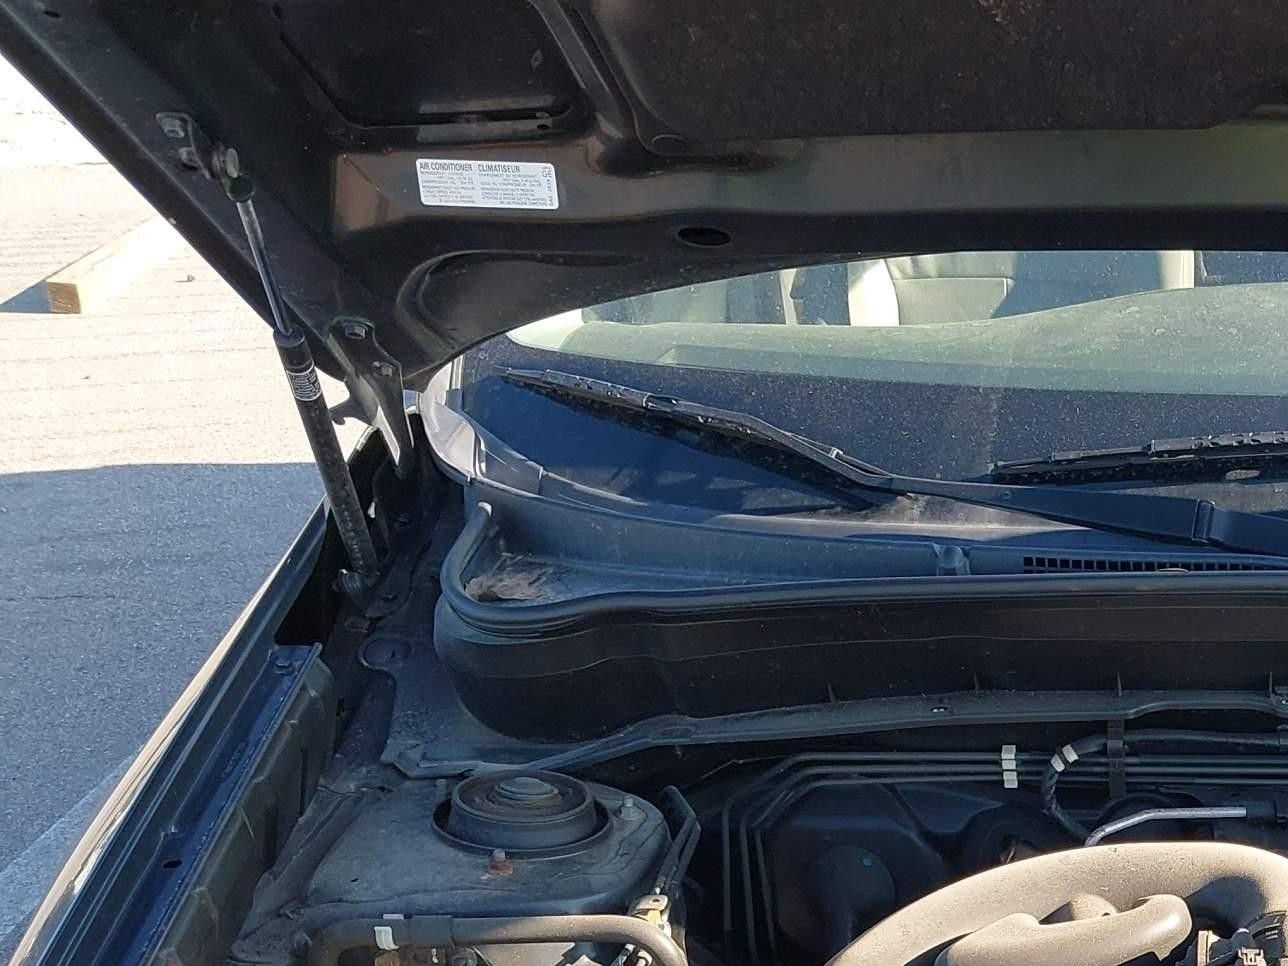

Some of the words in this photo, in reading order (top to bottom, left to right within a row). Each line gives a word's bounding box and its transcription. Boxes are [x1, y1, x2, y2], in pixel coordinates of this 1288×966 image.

[419, 162, 430, 170] AIR
[430, 163, 473, 172] CONDITIONER
[477, 163, 521, 173] CLIMATISEUR
[541, 170, 553, 178] GE
